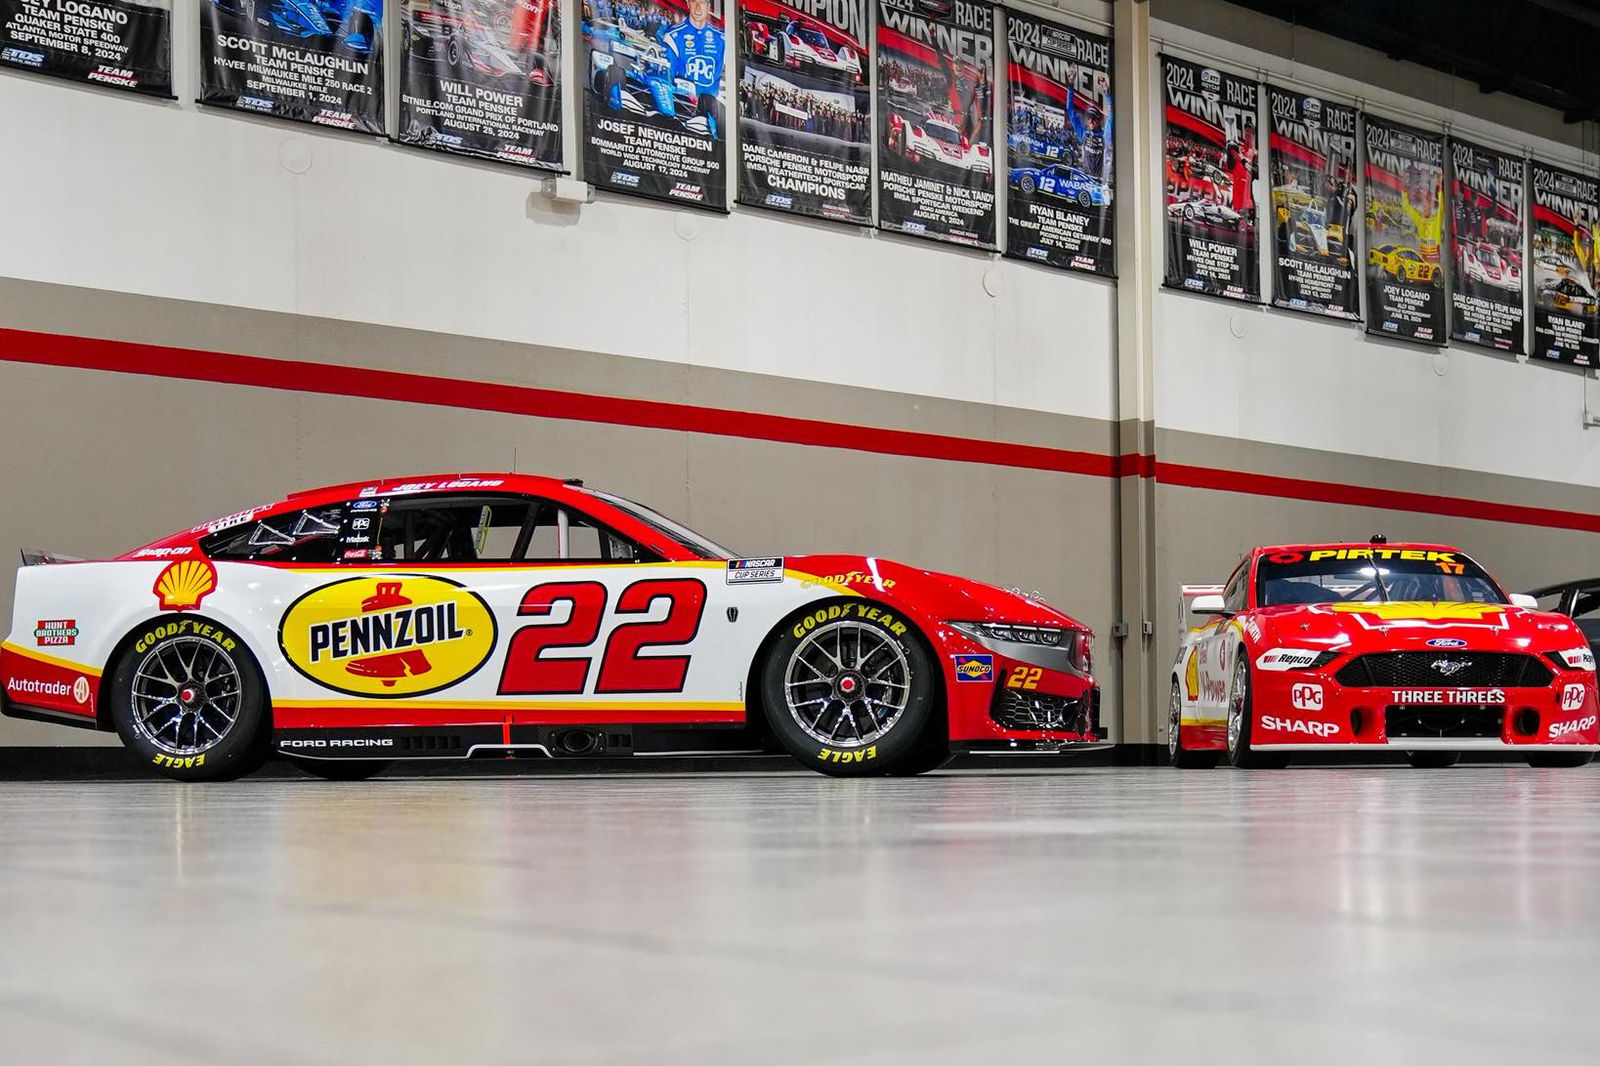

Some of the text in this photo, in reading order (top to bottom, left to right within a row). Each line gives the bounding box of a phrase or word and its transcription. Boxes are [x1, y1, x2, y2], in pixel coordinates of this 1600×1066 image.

[22, 4, 114, 32] TEAM PENSKE
[56, 0, 128, 24] LOGANO
[955, 0, 992, 32] RACE
[6, 22, 128, 54] ATLANTA MOTOR SPEEDWAY
[15, 14, 120, 44] QUAKER STATE 400
[880, 3, 993, 76] WINNER
[10, 30, 122, 60] SEPTEMBER 8, 2024
[1008, 17, 1040, 47] 2024
[1076, 38, 1108, 68] RACE
[217, 34, 368, 74] SCOTT McLAUGHLIN
[98, 64, 134, 78] TEAM
[254, 54, 334, 78] TEAM PENSKE
[686, 58, 714, 80] PPG
[1009, 41, 1110, 105] WINNER
[88, 73, 138, 88] PENSKE
[248, 63, 299, 80] MILWAUKEE
[302, 74, 322, 84] MILE
[325, 78, 340, 88] 250
[342, 82, 365, 93] RACE
[262, 76, 328, 93] MILWAUKEE MILE
[1167, 62, 1256, 107] 2024 RACE
[247, 80, 342, 104] SEPTEMBER 1, 2024
[440, 80, 523, 107] WILL POWER
[320, 108, 352, 118] TEAM
[402, 94, 453, 111] BITNILE.COM
[455, 106, 484, 117] GRAND
[486, 112, 503, 122] PRIX
[518, 118, 558, 132] PORTLAND
[446, 94, 518, 116] TEAM PENSKE
[1272, 92, 1354, 133] 2024 RACE
[312, 116, 357, 129] PENSKE
[416, 106, 544, 136] PORTLAND INTERNATIONAL RACEWAY
[444, 119, 520, 139] AUGUST 25, 2024
[598, 119, 712, 151] JOSEF NEWGARDEN
[624, 136, 687, 155] TEAM PENSKE
[1273, 113, 1355, 164] WINNR
[1366, 124, 1389, 150] 2024
[1416, 138, 1442, 163] RACE
[504, 144, 533, 155] TEAM
[592, 137, 719, 169] BOMMARITO AUTOMOTIVE GROUP 500
[742, 144, 766, 155] DANE
[767, 149, 809, 164] CAMERON
[820, 159, 844, 171] FELIPE
[846, 165, 869, 175] NASR
[1046, 146, 1059, 158] 12
[600, 148, 710, 174] WORLD WIDE TECHNOLOGY RACEWAY
[623, 159, 688, 177] AUGUST 17, 2024
[744, 152, 868, 183] PORSCHE PENSKE MOTORSPORT
[1452, 142, 1522, 181] 2024 RACE
[746, 161, 865, 190] IMSA WEATHERTECH SPORTSCAR
[1039, 176, 1056, 193] 12
[1534, 168, 1554, 191] 2024
[1576, 180, 1598, 203] RACE
[669, 189, 703, 200] PENSKE
[676, 182, 700, 192] TEAM
[767, 175, 845, 200] CHAMPIONS
[881, 171, 994, 203] MATHIEU JAMINET & NICK TANDY
[884, 182, 992, 211] PORSCHE PENSKE MOTORSPORT
[913, 210, 939, 220] AUGUST
[1029, 204, 1089, 227] RYAN BLANEY
[1038, 215, 1083, 232] TEAM PENSKE
[1040, 237, 1054, 246] JULY
[1189, 239, 1237, 256] WILL POWER
[1192, 248, 1209, 258] TEAM
[1279, 258, 1351, 279] SCOTT McLAUGHLIN
[1418, 265, 1429, 279] 22
[1384, 285, 1430, 301] JOEY LOGANO
[744, 559, 775, 568] NASCAR
[1310, 549, 1456, 563] PIRTEK
[734, 569, 776, 579] CUP SERIES
[1436, 562, 1465, 574] 17
[36, 629, 76, 637] BROTHERS
[309, 601, 464, 662] PENNZOIL
[496, 577, 707, 695] 22
[1434, 639, 1458, 647] Ford
[956, 664, 991, 674] SUNOCO
[1278, 654, 1312, 665] Repco
[8, 677, 72, 696] Autotrader
[1006, 666, 1043, 689] 22
[1294, 686, 1322, 706] PPG
[1392, 691, 1505, 704] THREE THREES
[1564, 687, 1583, 708] PPG
[1261, 715, 1340, 738] SHARP
[1548, 716, 1596, 738] SHARP
[279, 738, 393, 748] FORD RACING
[818, 745, 877, 763] EAGLE
[152, 752, 205, 769] EAGLE
